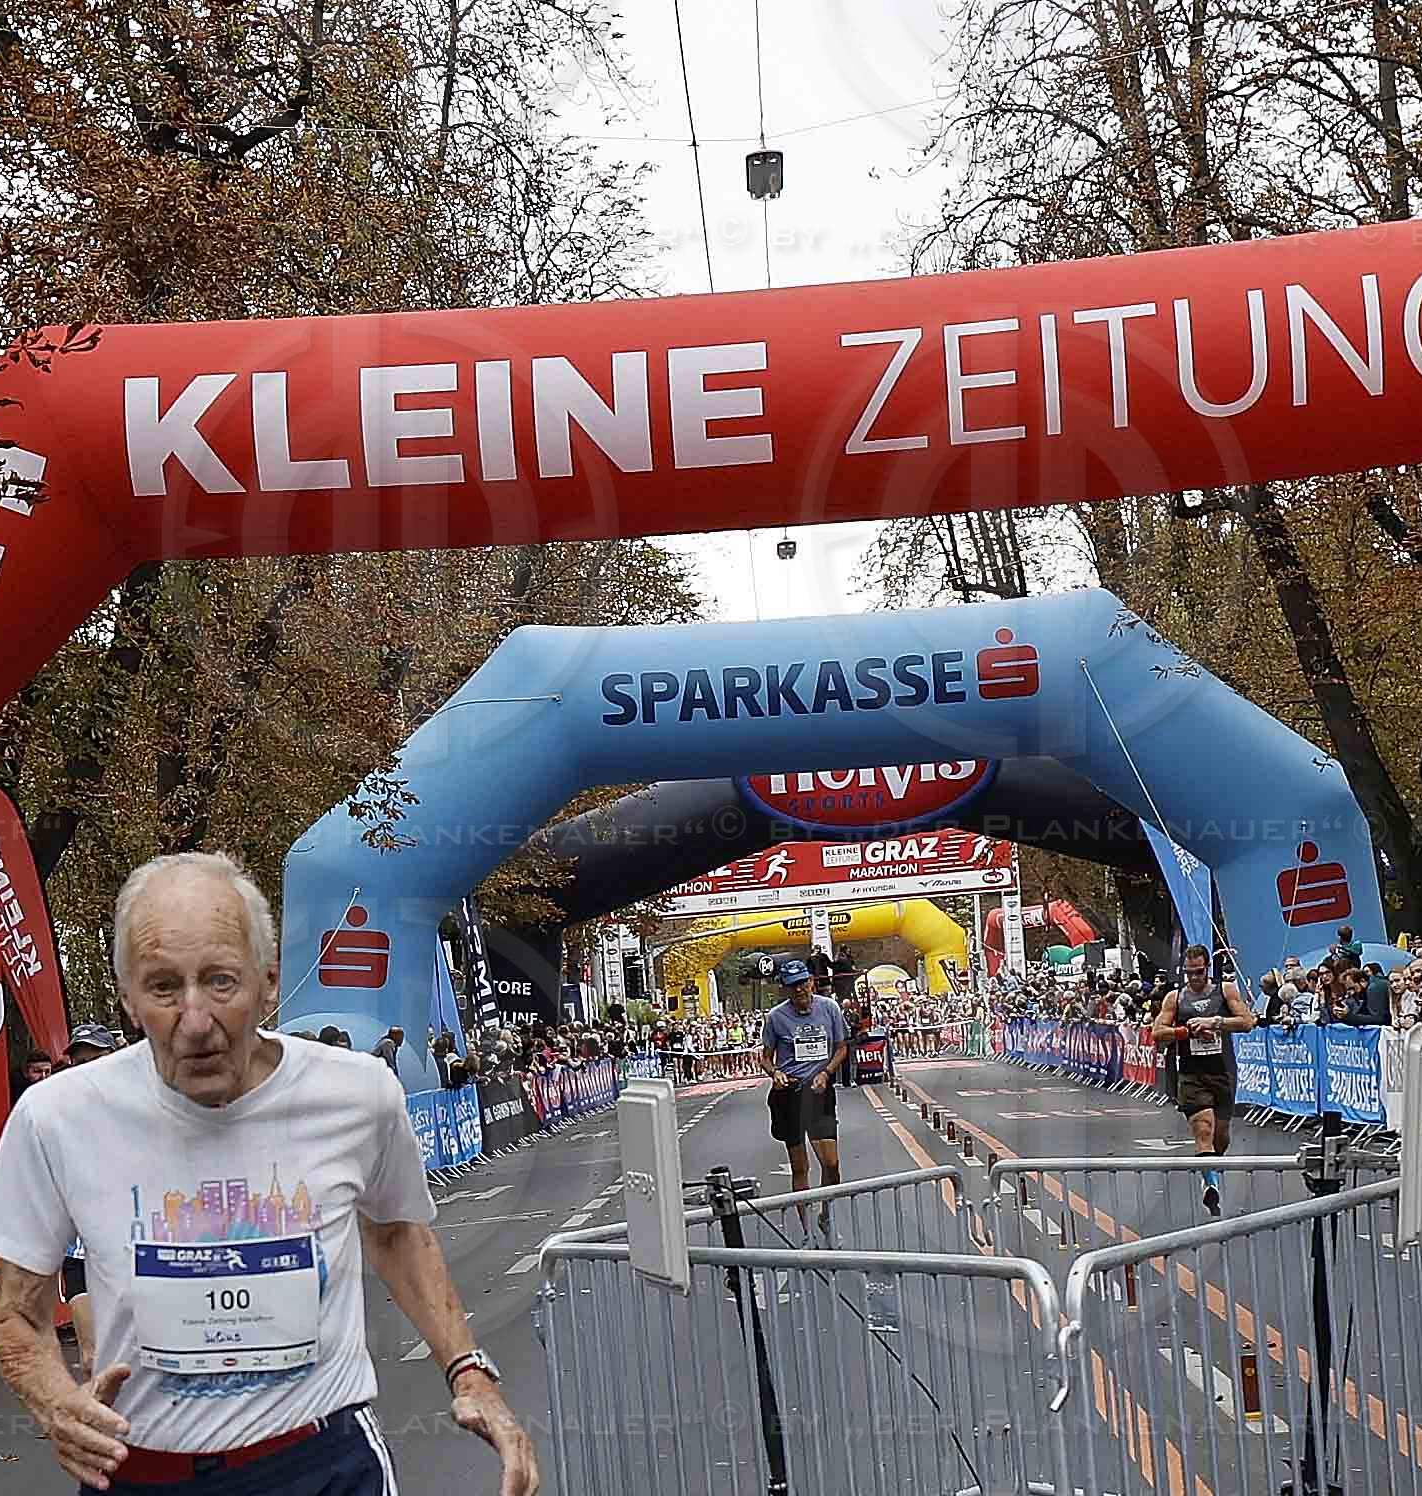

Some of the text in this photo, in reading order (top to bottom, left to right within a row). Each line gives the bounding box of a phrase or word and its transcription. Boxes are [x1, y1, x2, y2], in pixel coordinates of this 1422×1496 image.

[124, 341, 774, 497] KLEINE
[601, 650, 967, 727] SPARKASSE
[864, 836, 940, 865] GRAZ
[849, 863, 919, 881] MARATHON
[204, 1288, 251, 1311] 100
